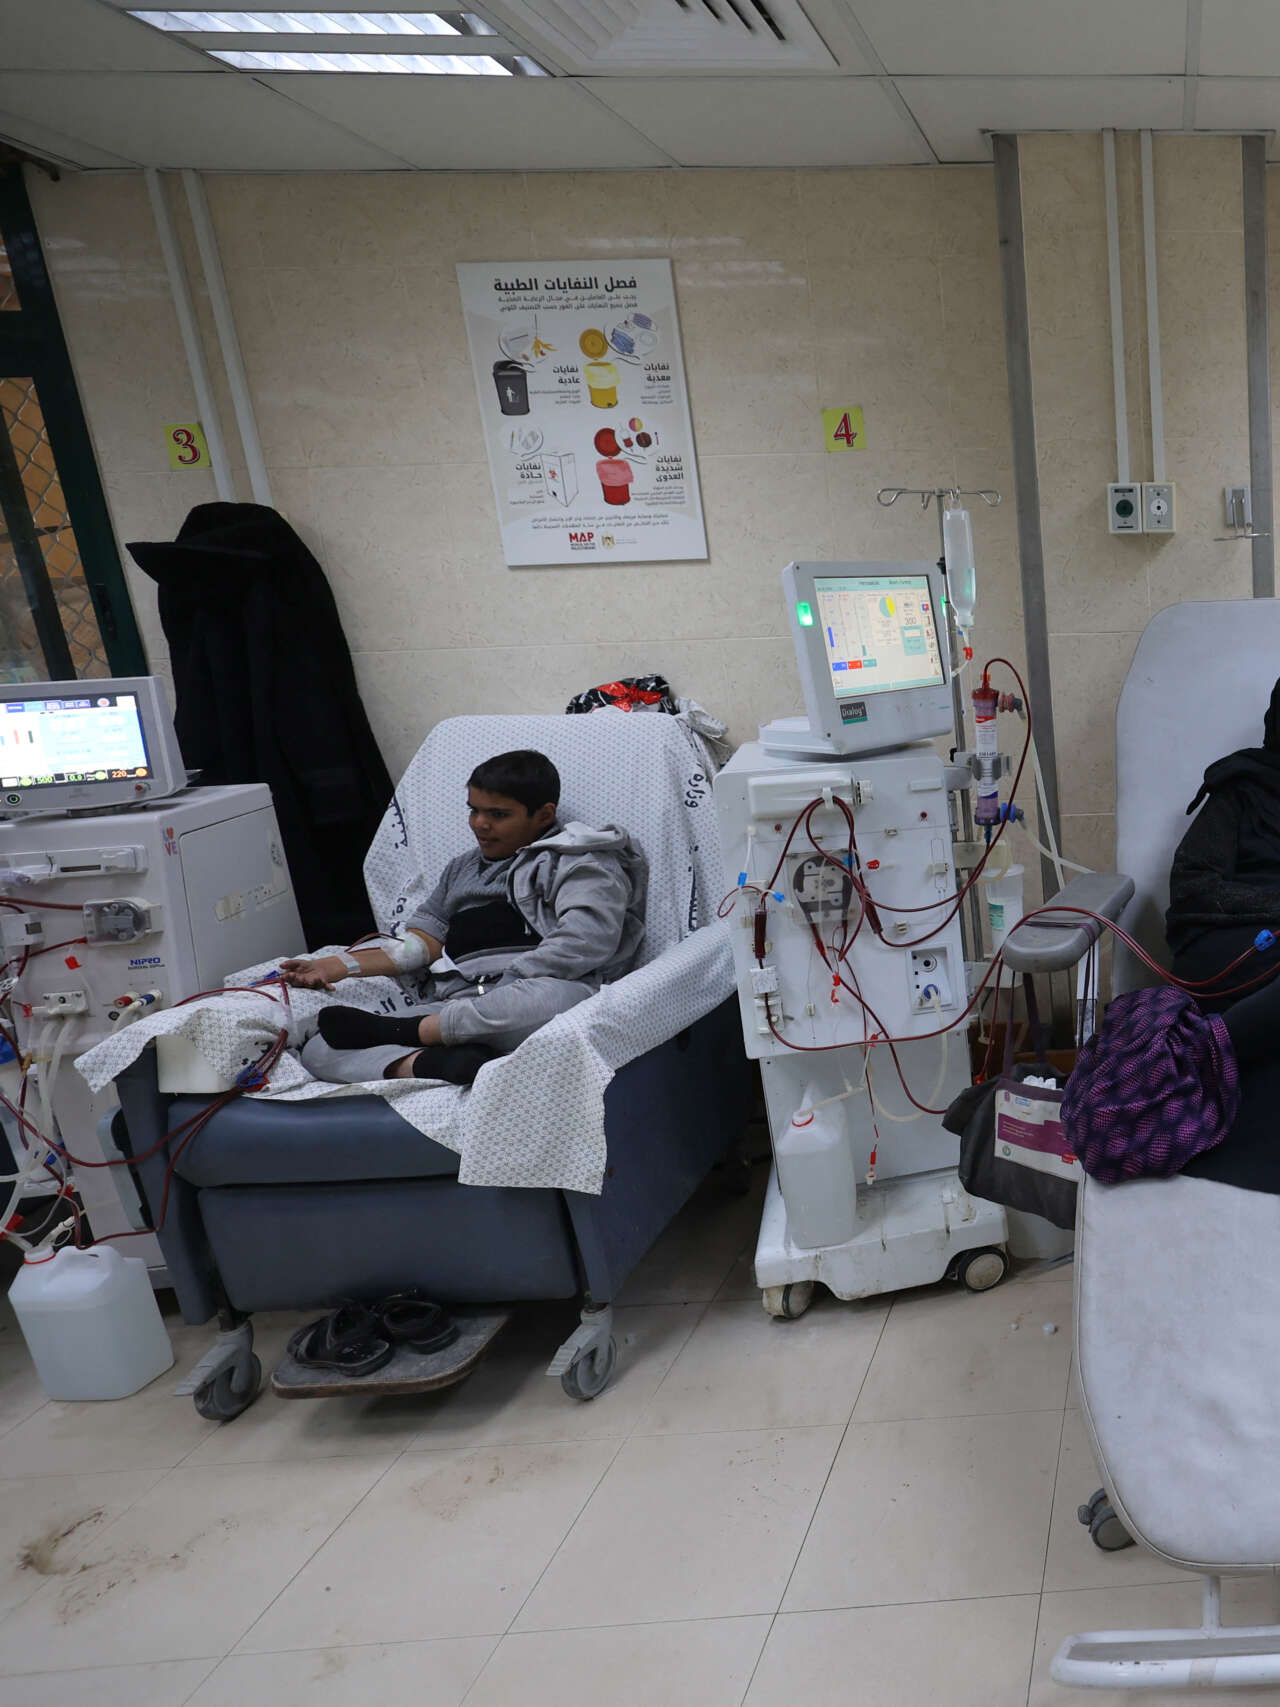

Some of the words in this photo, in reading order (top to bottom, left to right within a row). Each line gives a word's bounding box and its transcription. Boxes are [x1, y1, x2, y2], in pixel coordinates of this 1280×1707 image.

[493, 277, 539, 295] الطبية
[544, 276, 599, 294] النفايات
[604, 276, 637, 293] فصل
[552, 364, 579, 375] نفايات
[643, 362, 670, 373] نفايات
[558, 375, 580, 386] عادية
[646, 374, 671, 384] معدية
[833, 412, 857, 448] 4
[172, 428, 200, 465] 3
[656, 455, 682, 465] نفايات
[515, 462, 541, 472] نفايات
[655, 463, 683, 472] شديدة
[520, 471, 543, 479] حادة
[656, 472, 684, 483] العدوى
[569, 532, 594, 543] MAP
[111, 770, 127, 778] 220
[684, 773, 708, 809] وزارة
[129, 957, 161, 966] NIPRO
